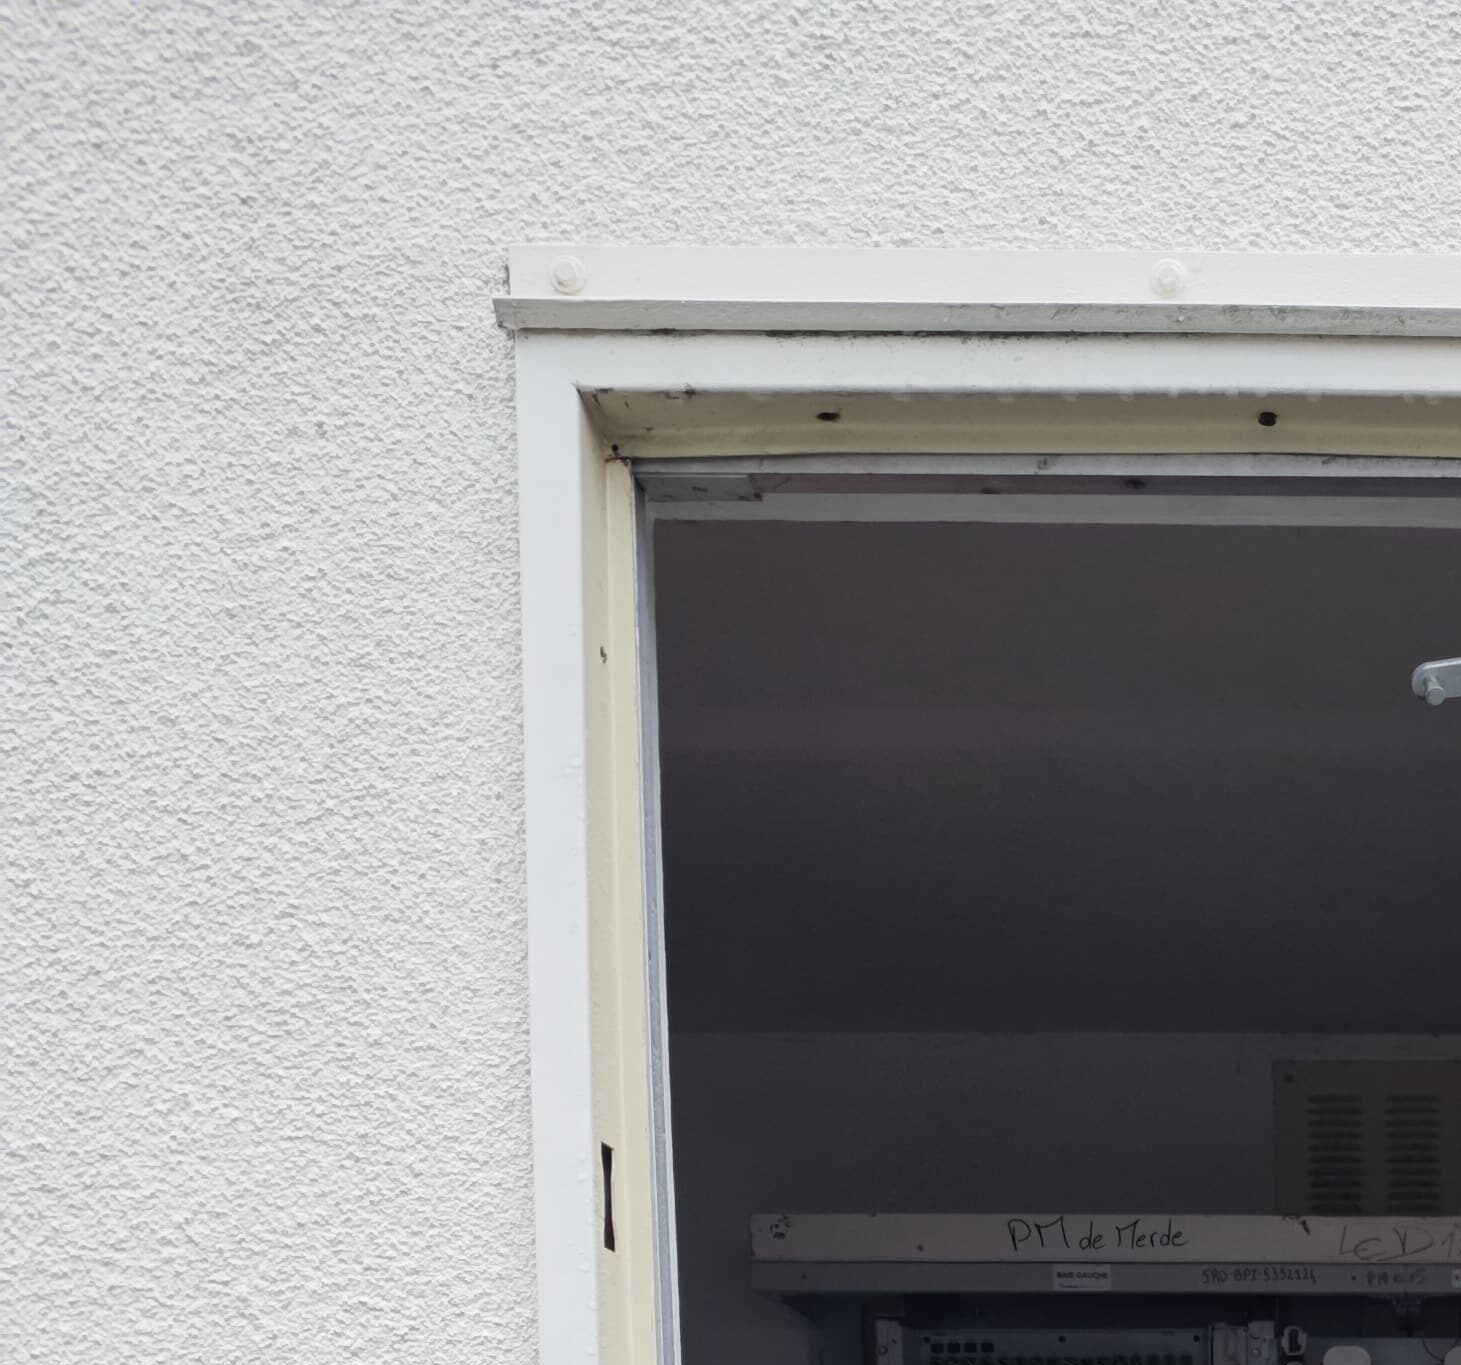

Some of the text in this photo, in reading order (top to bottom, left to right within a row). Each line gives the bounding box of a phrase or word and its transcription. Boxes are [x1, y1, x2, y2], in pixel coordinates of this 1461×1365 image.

[1007, 1215, 1188, 1251] PM de Merde
